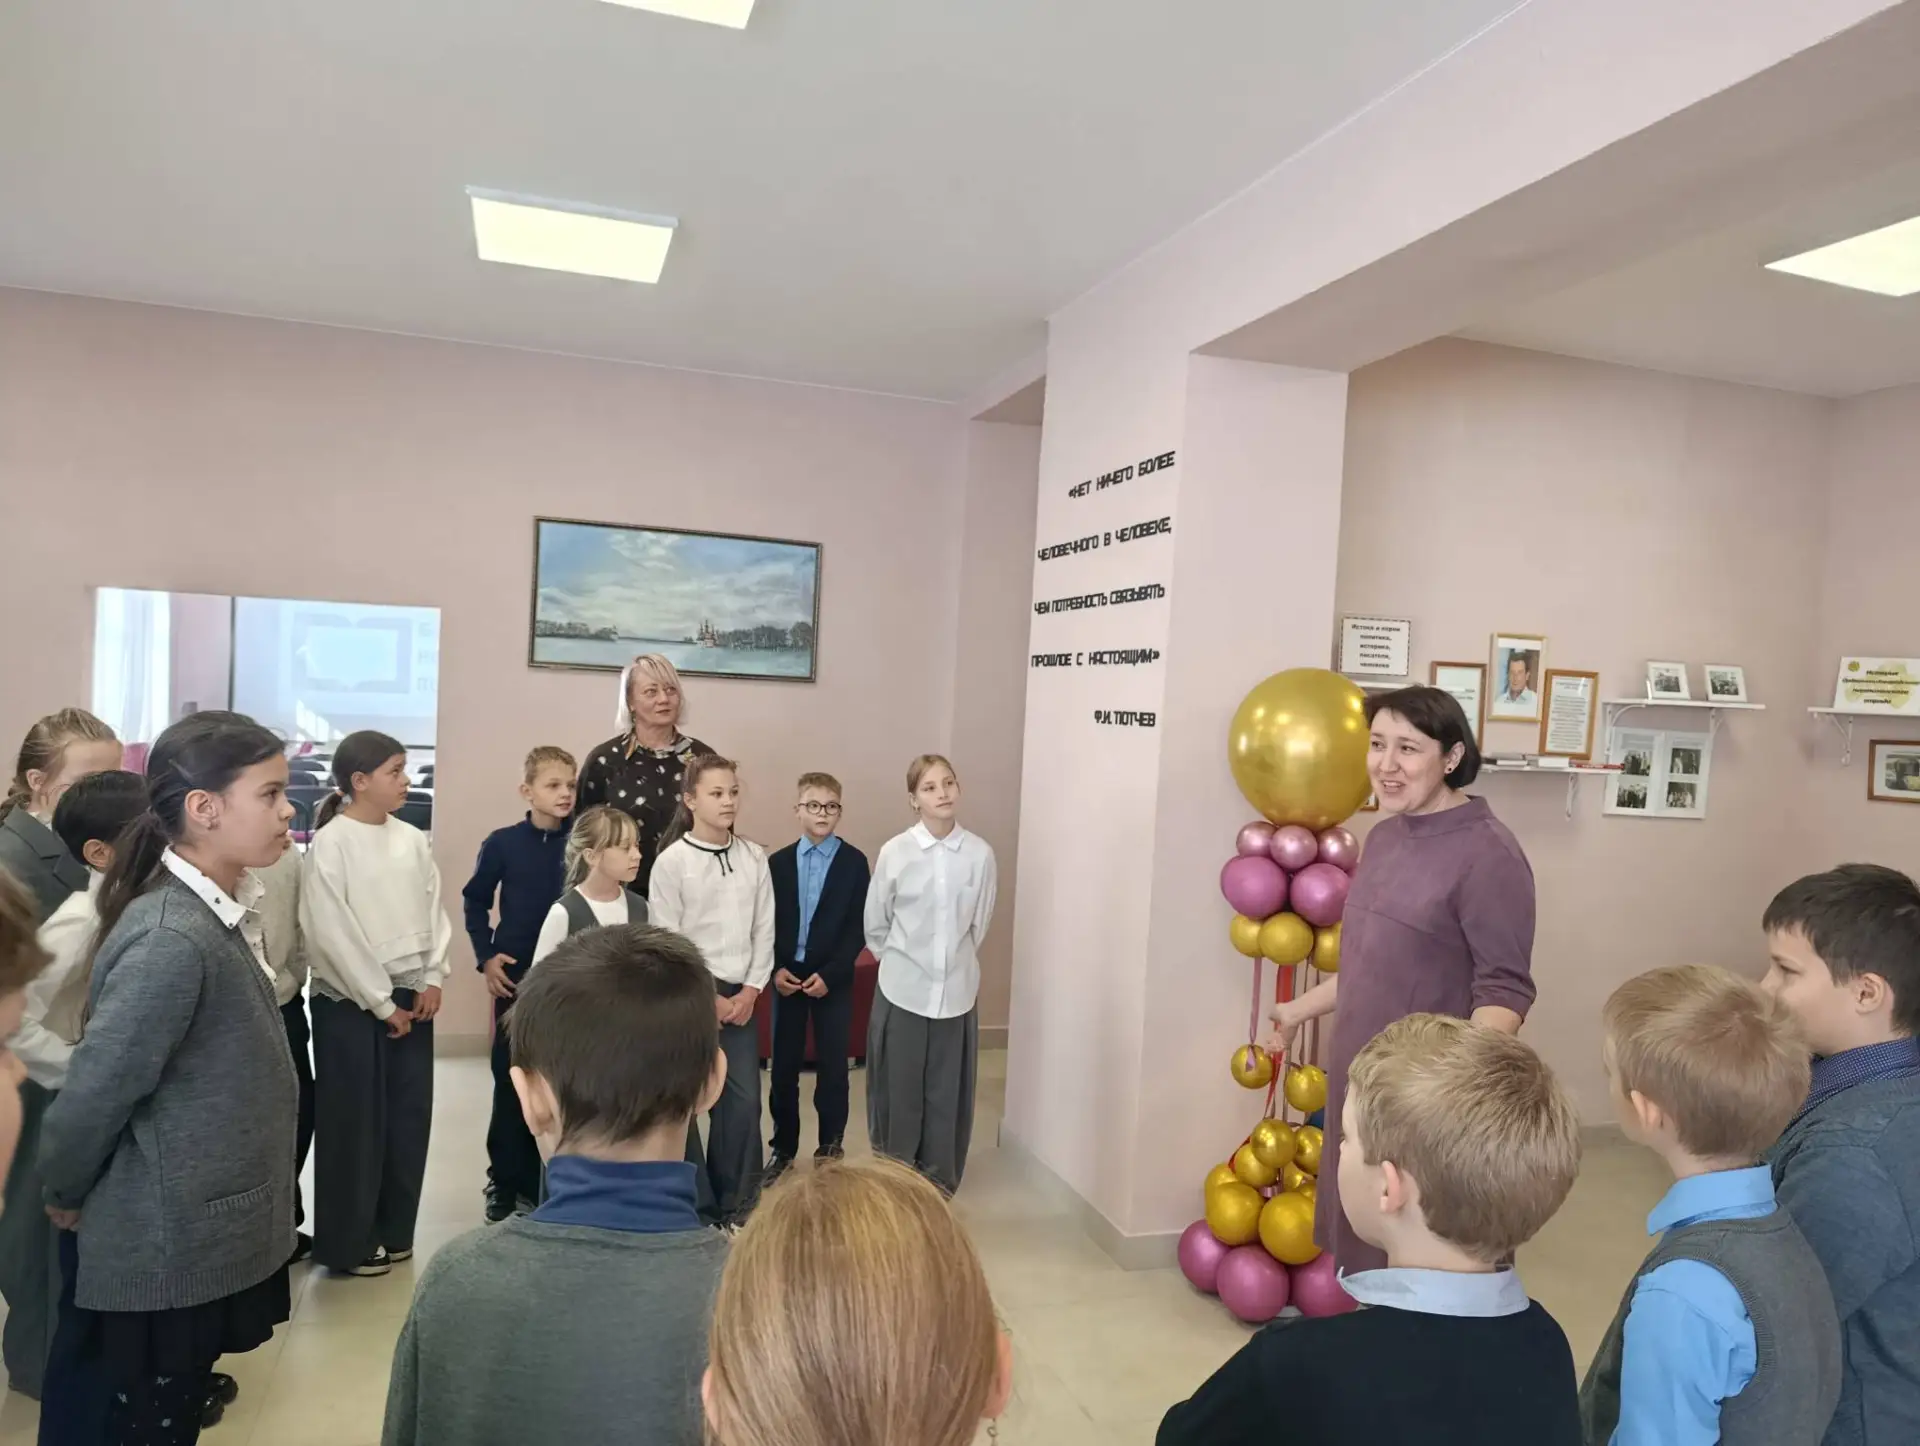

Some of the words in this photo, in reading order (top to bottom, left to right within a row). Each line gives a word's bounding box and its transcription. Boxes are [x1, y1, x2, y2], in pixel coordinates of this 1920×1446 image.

[1068, 480, 1092, 498] «НЕТ
[1096, 465, 1133, 491] НИЧЕГО
[1138, 451, 1175, 476] БОЛЕЕ
[1037, 534, 1099, 561] ЧЕЛОВЕЧНОГО
[1103, 532, 1111, 546] В
[1115, 516, 1172, 543] ЧЕЛОВЕКЕ,
[1034, 601, 1050, 615] ЧЕМ
[1051, 592, 1108, 613] ПОТРЕБНОСТЬ
[1110, 583, 1165, 605] СВЯЗЫВАТЬ
[1031, 653, 1072, 668] ПРОШЛОЕ
[1076, 652, 1084, 666] С
[1088, 648, 1160, 667] НАСТОЯЩИМ»
[1113, 711, 1156, 727] ТЮТЧЕВ
